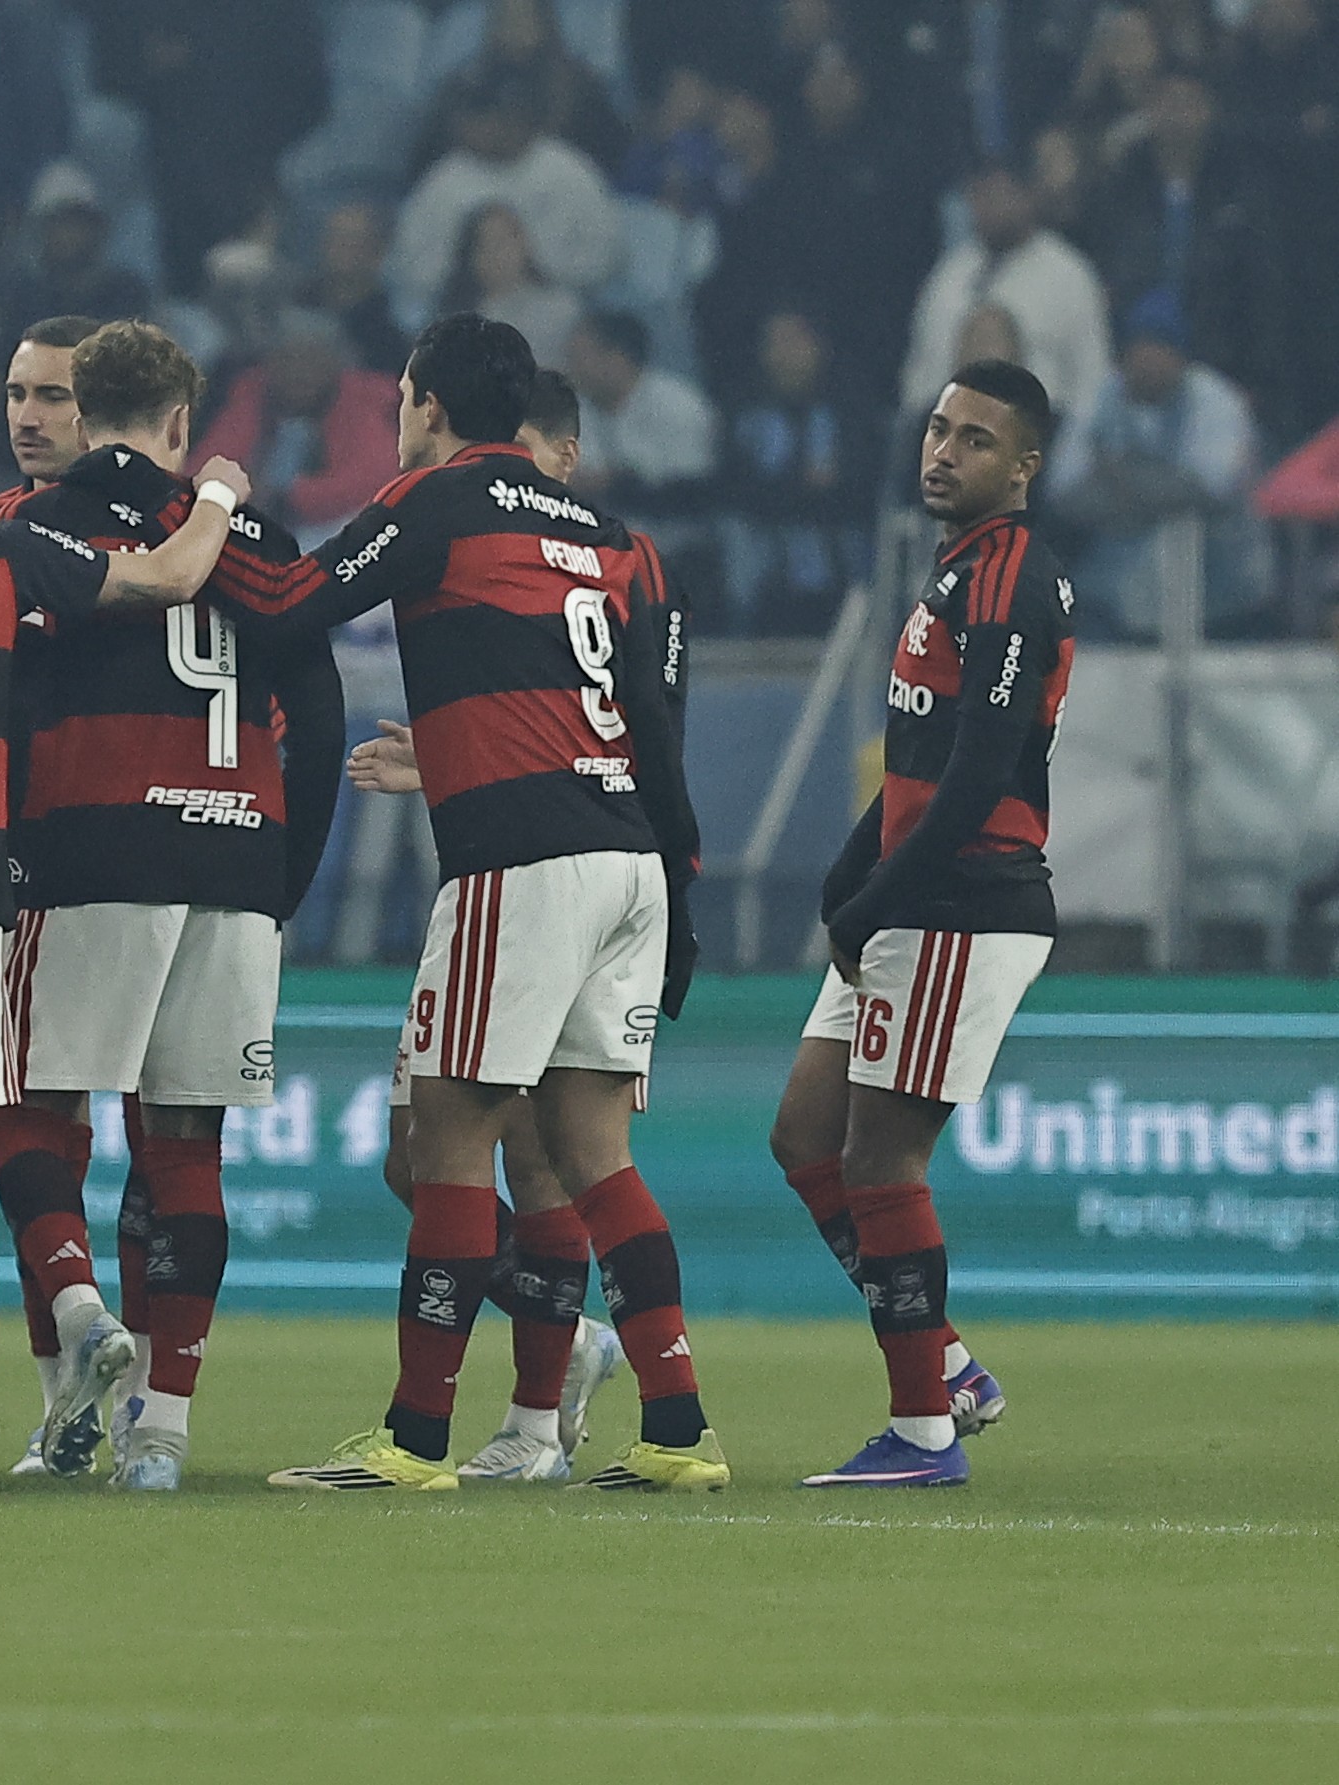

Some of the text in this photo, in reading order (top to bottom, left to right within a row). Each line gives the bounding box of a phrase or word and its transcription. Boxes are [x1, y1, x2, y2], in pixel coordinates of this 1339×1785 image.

[518, 484, 599, 528] Hapvida
[335, 523, 401, 583] Shopee
[540, 537, 603, 579] PEDRO
[564, 587, 627, 742] 9
[664, 610, 683, 686] Shopee
[989, 632, 1024, 708] Shopee
[166, 602, 239, 769] 4
[145, 786, 257, 810] ASSIST
[181, 806, 263, 830] CARD
[415, 989, 437, 1053] 9
[623, 1032, 655, 1045] GA
[240, 1067, 275, 1081] GA
[958, 1083, 1339, 1174] Unimed
